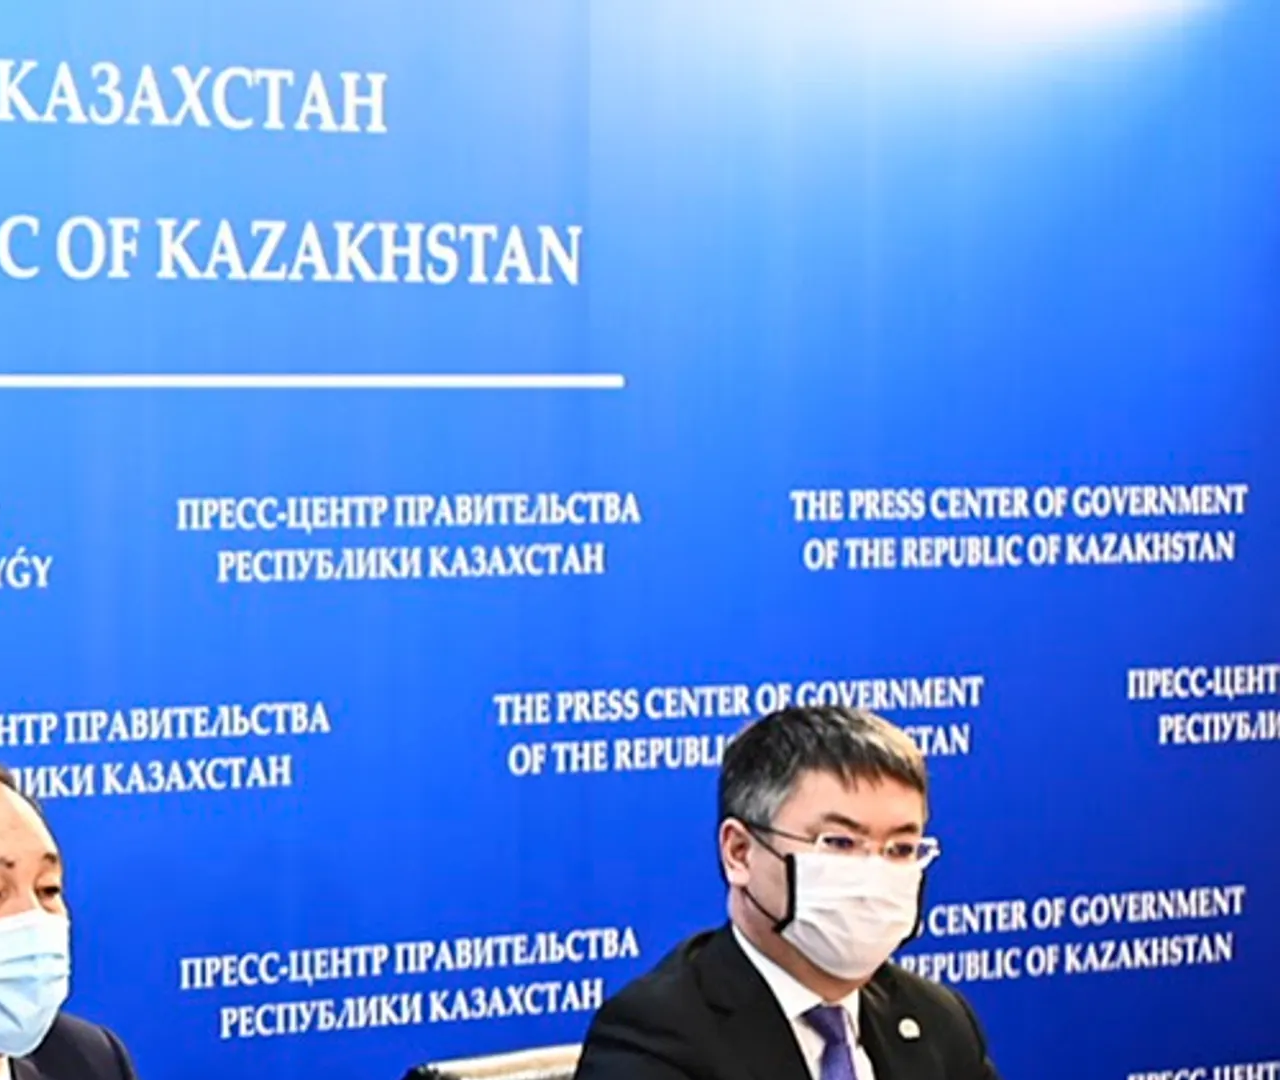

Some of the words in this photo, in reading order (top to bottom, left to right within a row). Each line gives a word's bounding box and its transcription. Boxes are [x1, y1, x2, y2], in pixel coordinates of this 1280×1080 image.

[57, 217, 139, 279] OF
[157, 219, 581, 284] KAZAKHSTAN
[178, 496, 388, 533] ПРЕСС-ЦЕНТР
[394, 492, 640, 527] ПРАВИТЕЛЬСТВА
[790, 490, 844, 522] THE
[849, 488, 926, 520] PRESS
[930, 487, 1031, 520] CENTER
[1033, 486, 1069, 518] OF
[1072, 484, 1249, 518] GOVERNMENT
[218, 547, 422, 583] РЕСПУБЛИКИ
[429, 542, 604, 578] КАЗАХСТАН
[803, 538, 840, 570] OF
[843, 537, 897, 569] THE
[901, 534, 1024, 568] REPUBLIC
[1027, 533, 1061, 566] OF
[1065, 531, 1235, 564] KAZAKHSTAN
[64, 701, 330, 744] ПРАВИТЕЛЬСТВА
[494, 693, 553, 726] THE
[556, 690, 640, 724] PRESS
[643, 685, 751, 720] CENTER
[755, 682, 791, 715] OF
[795, 676, 985, 711] GOVERNMENT
[103, 754, 292, 795] КАЗАХСТАН
[507, 745, 547, 776] OF
[550, 740, 608, 774] THE
[928, 903, 1029, 937] CENTER
[1032, 897, 1068, 929] OF
[1070, 885, 1246, 925] GOVERNMENT
[180, 944, 389, 990] ПРЕСС-ЦЕНТР
[395, 926, 639, 974] ПРАВИТЕЛЬСТВА
[1025, 944, 1063, 977] OF
[1064, 932, 1234, 973] KAZAKHSTAN
[221, 992, 422, 1039] РЕСПУБЛИКИ
[429, 978, 603, 1022] КАЗАХСТАН
